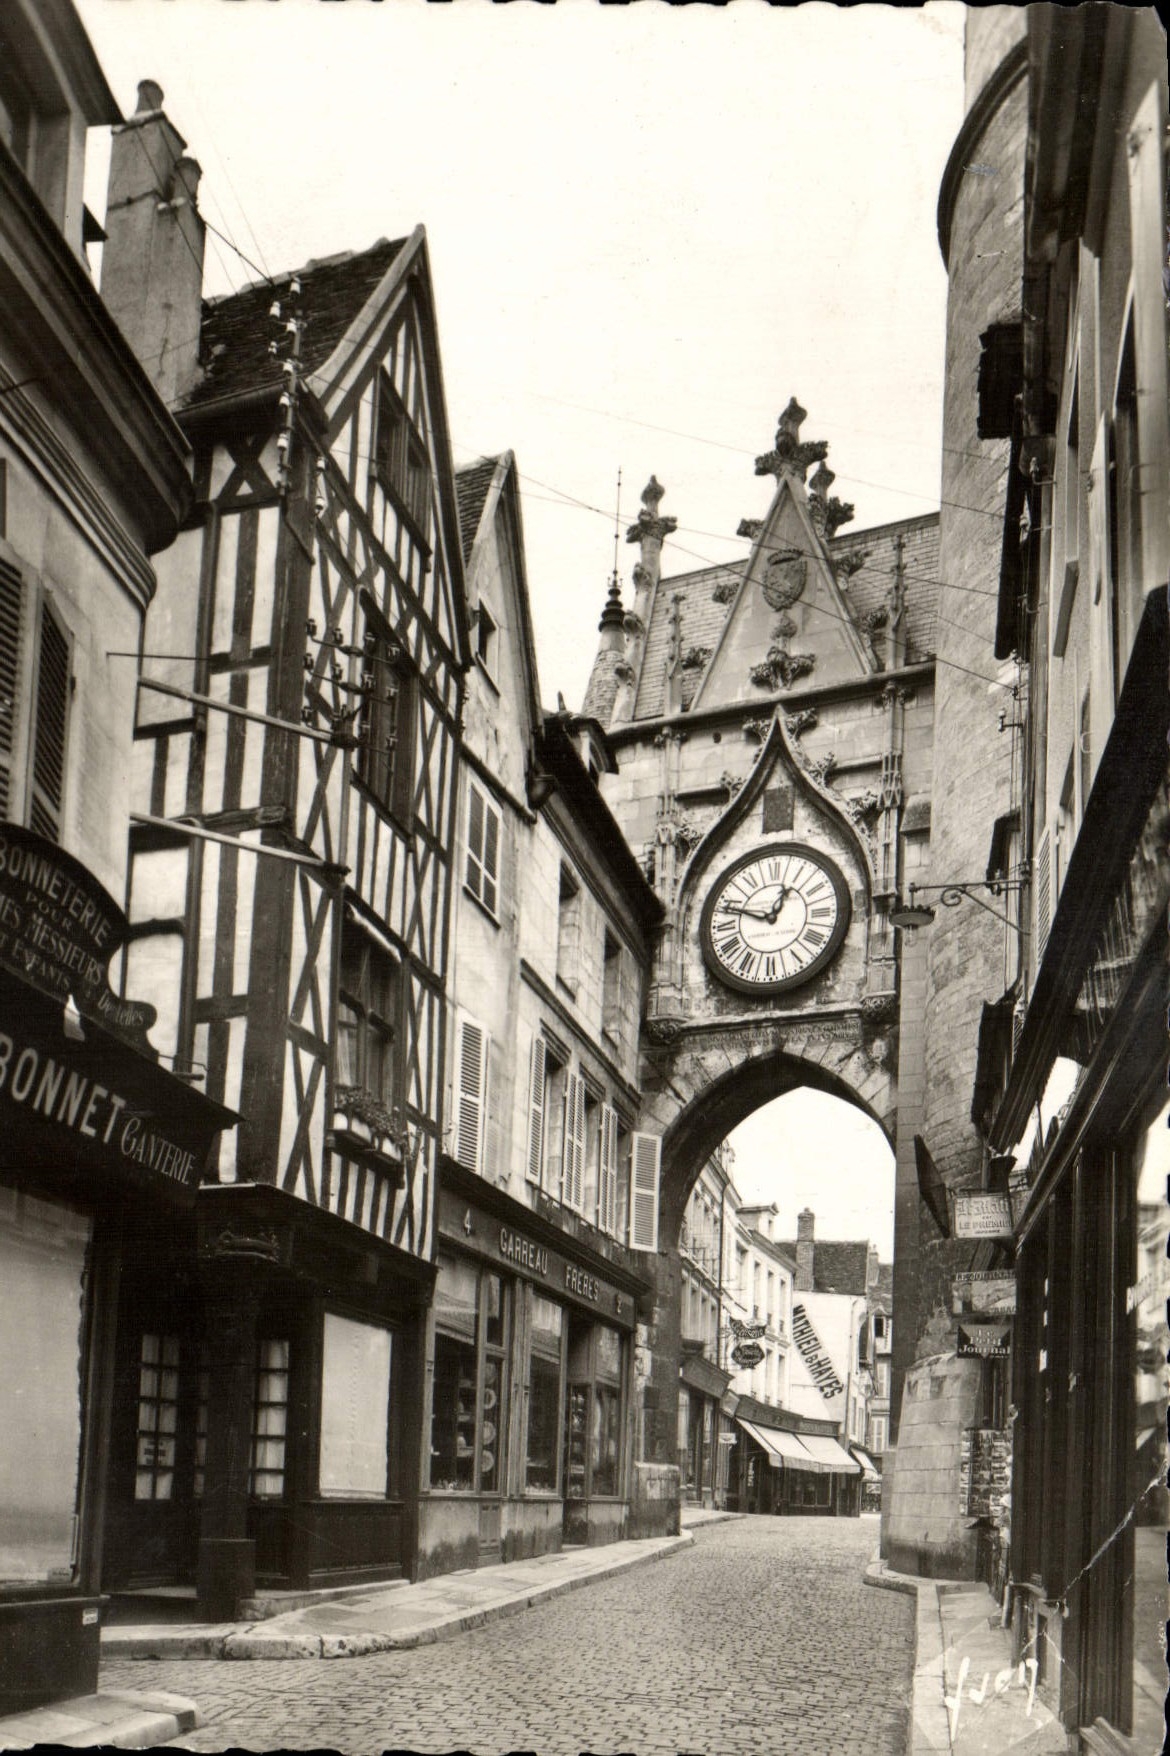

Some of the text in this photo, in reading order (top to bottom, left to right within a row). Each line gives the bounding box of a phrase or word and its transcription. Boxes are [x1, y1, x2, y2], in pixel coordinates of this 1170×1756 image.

[0, 1034, 126, 1144] BONNET
[500, 1228, 548, 1275] GARREAU
[792, 1303, 822, 1356] MATHIEU
[959, 1344, 1011, 1355] Journal
